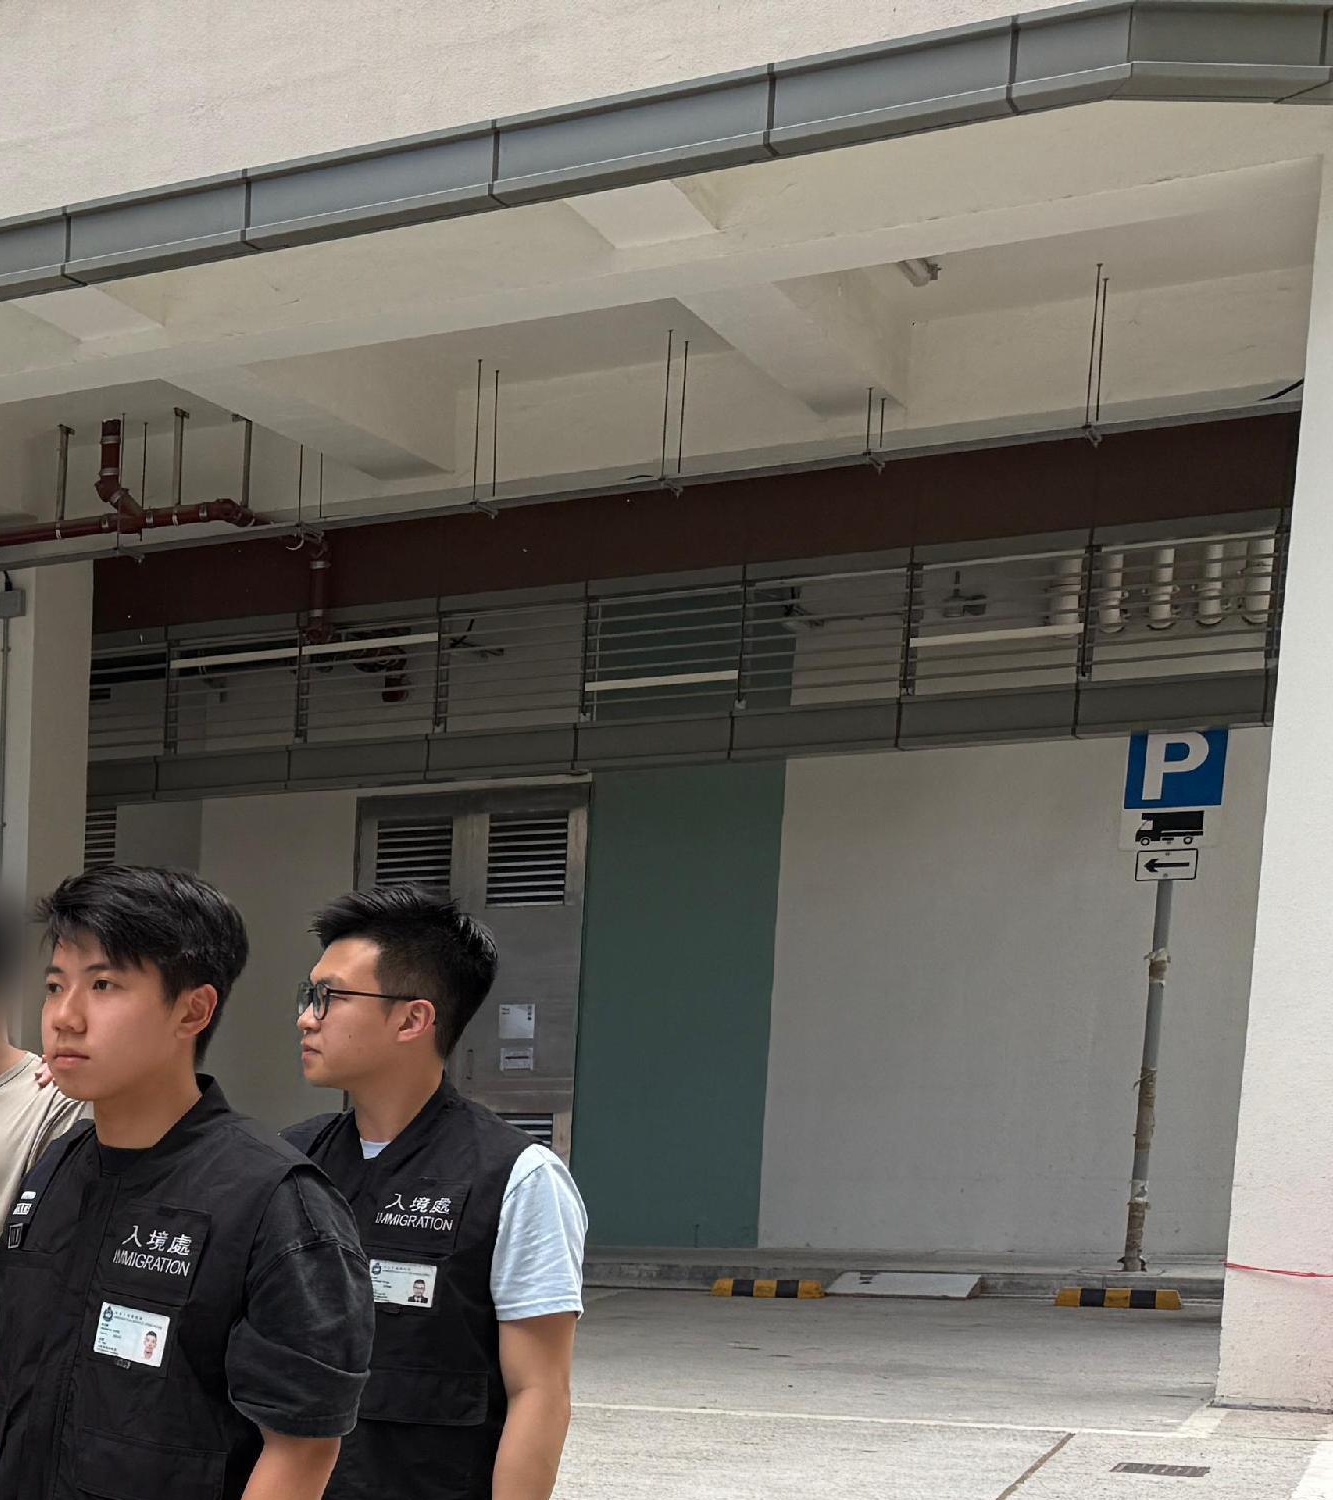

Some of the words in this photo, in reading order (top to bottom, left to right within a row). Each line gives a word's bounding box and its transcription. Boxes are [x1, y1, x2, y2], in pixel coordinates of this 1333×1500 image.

[1141, 731, 1210, 801] P
[384, 1192, 452, 1215] 入境處
[374, 1211, 454, 1232] IMMIGRATION
[121, 1224, 193, 1257] 入境處
[112, 1248, 192, 1278] IMMIGRATION
